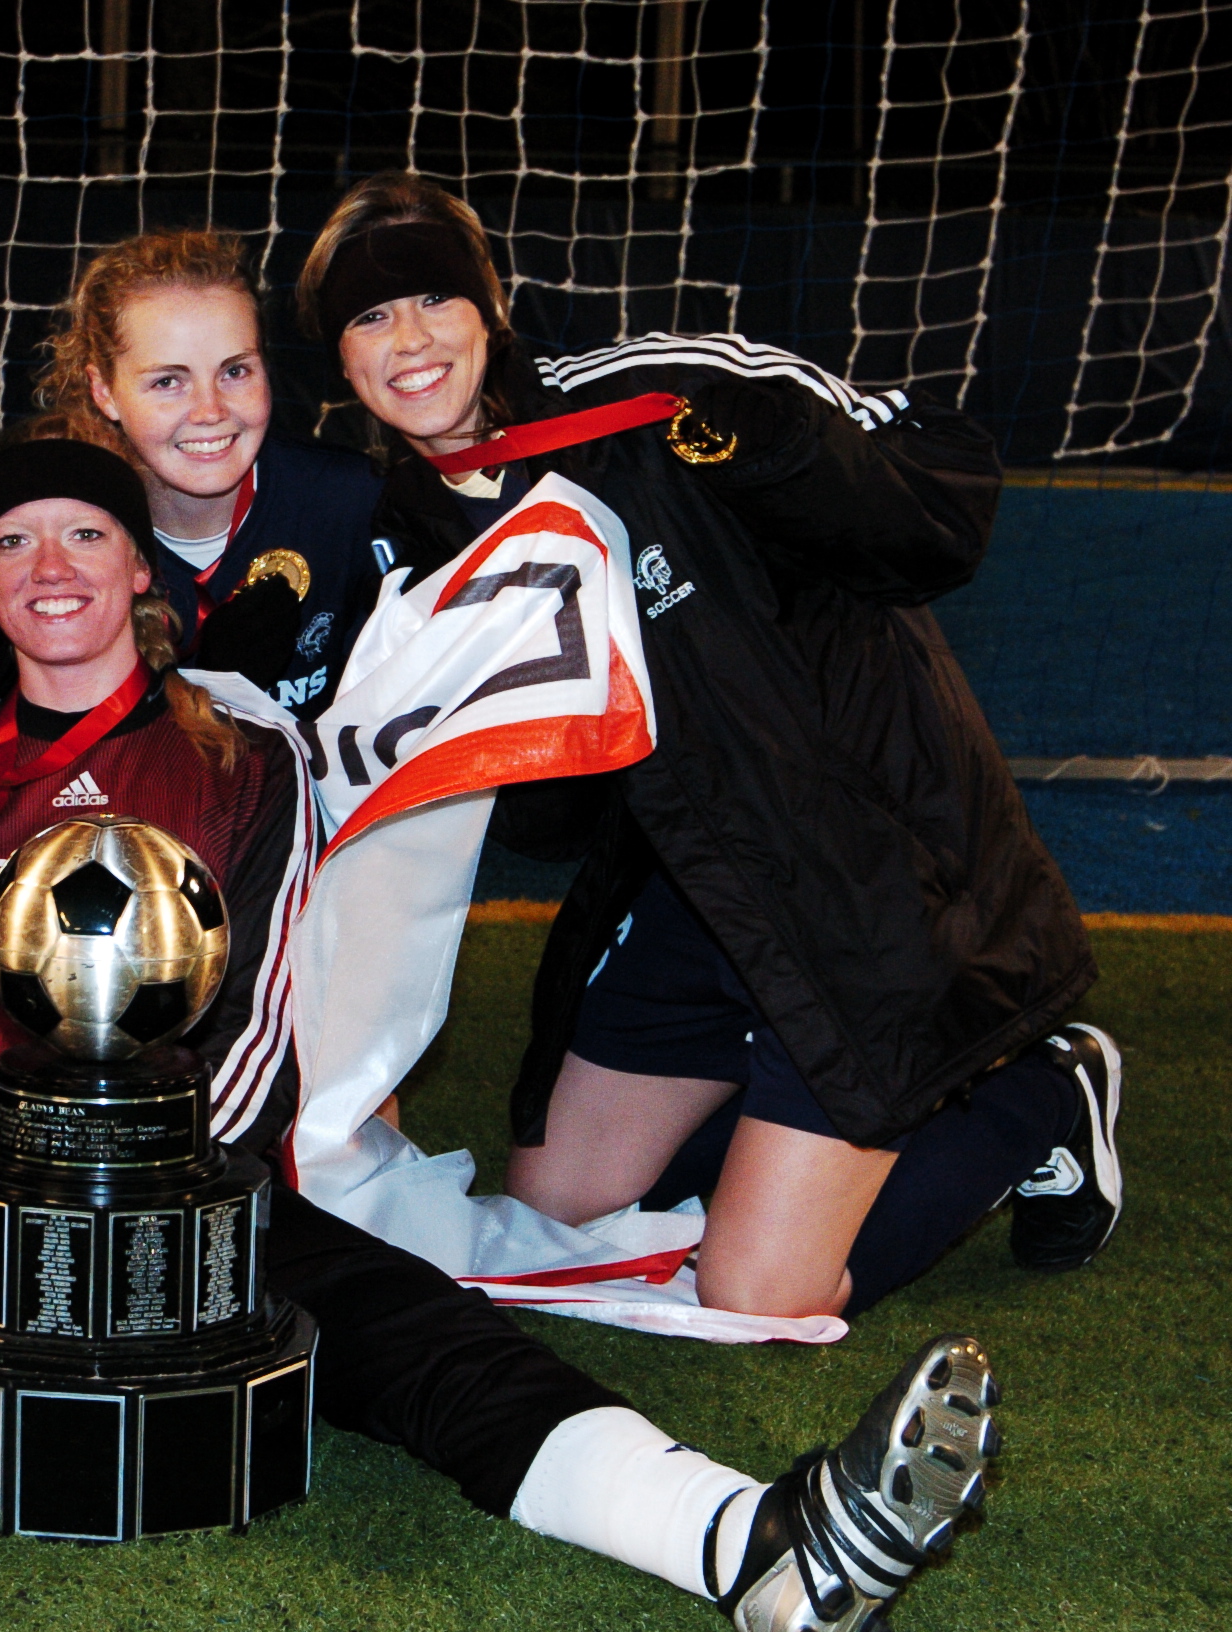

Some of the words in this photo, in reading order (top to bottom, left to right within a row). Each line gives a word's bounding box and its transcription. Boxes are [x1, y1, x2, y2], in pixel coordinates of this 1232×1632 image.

[646, 581, 696, 619] SOCCER
[265, 666, 327, 706] NS
[52, 793, 109, 808] adidas
